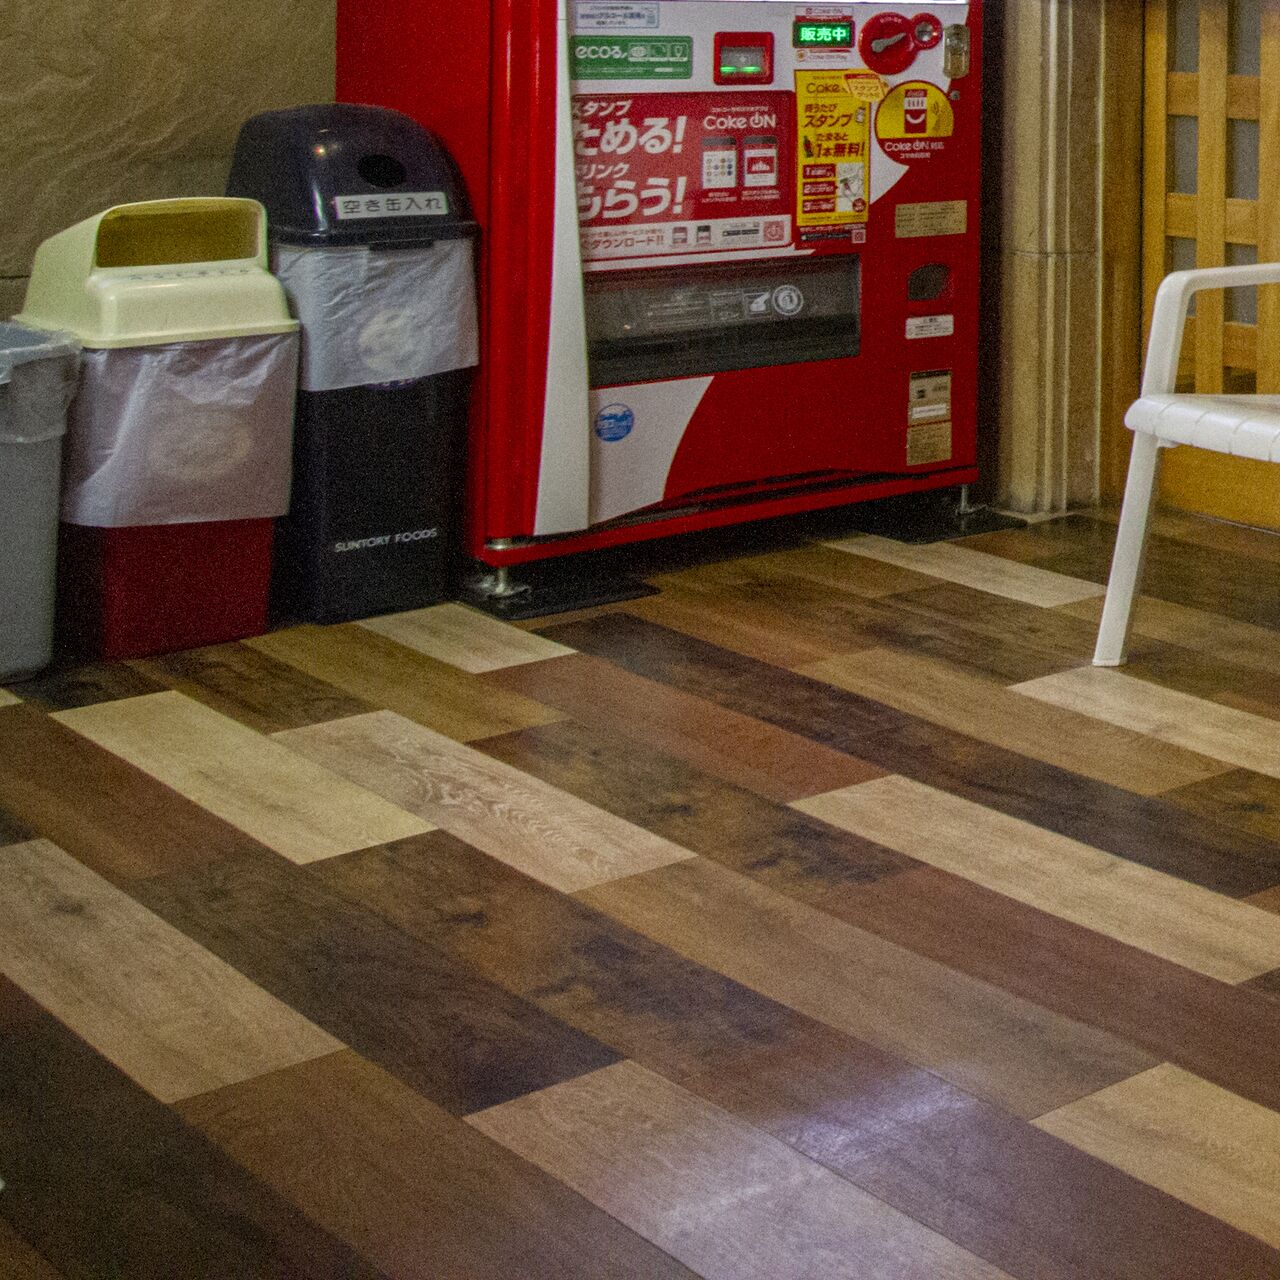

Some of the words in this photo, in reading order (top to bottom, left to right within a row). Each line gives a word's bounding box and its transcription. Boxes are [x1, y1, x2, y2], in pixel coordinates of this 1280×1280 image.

[800, 27, 847, 41] 販売中
[806, 82, 840, 94] Coke
[703, 115, 747, 130] Coke
[804, 113, 853, 127] スタンプ
[884, 141, 911, 151] Coke
[343, 197, 443, 214] 空き缶入れ
[395, 528, 438, 543] FOODS
